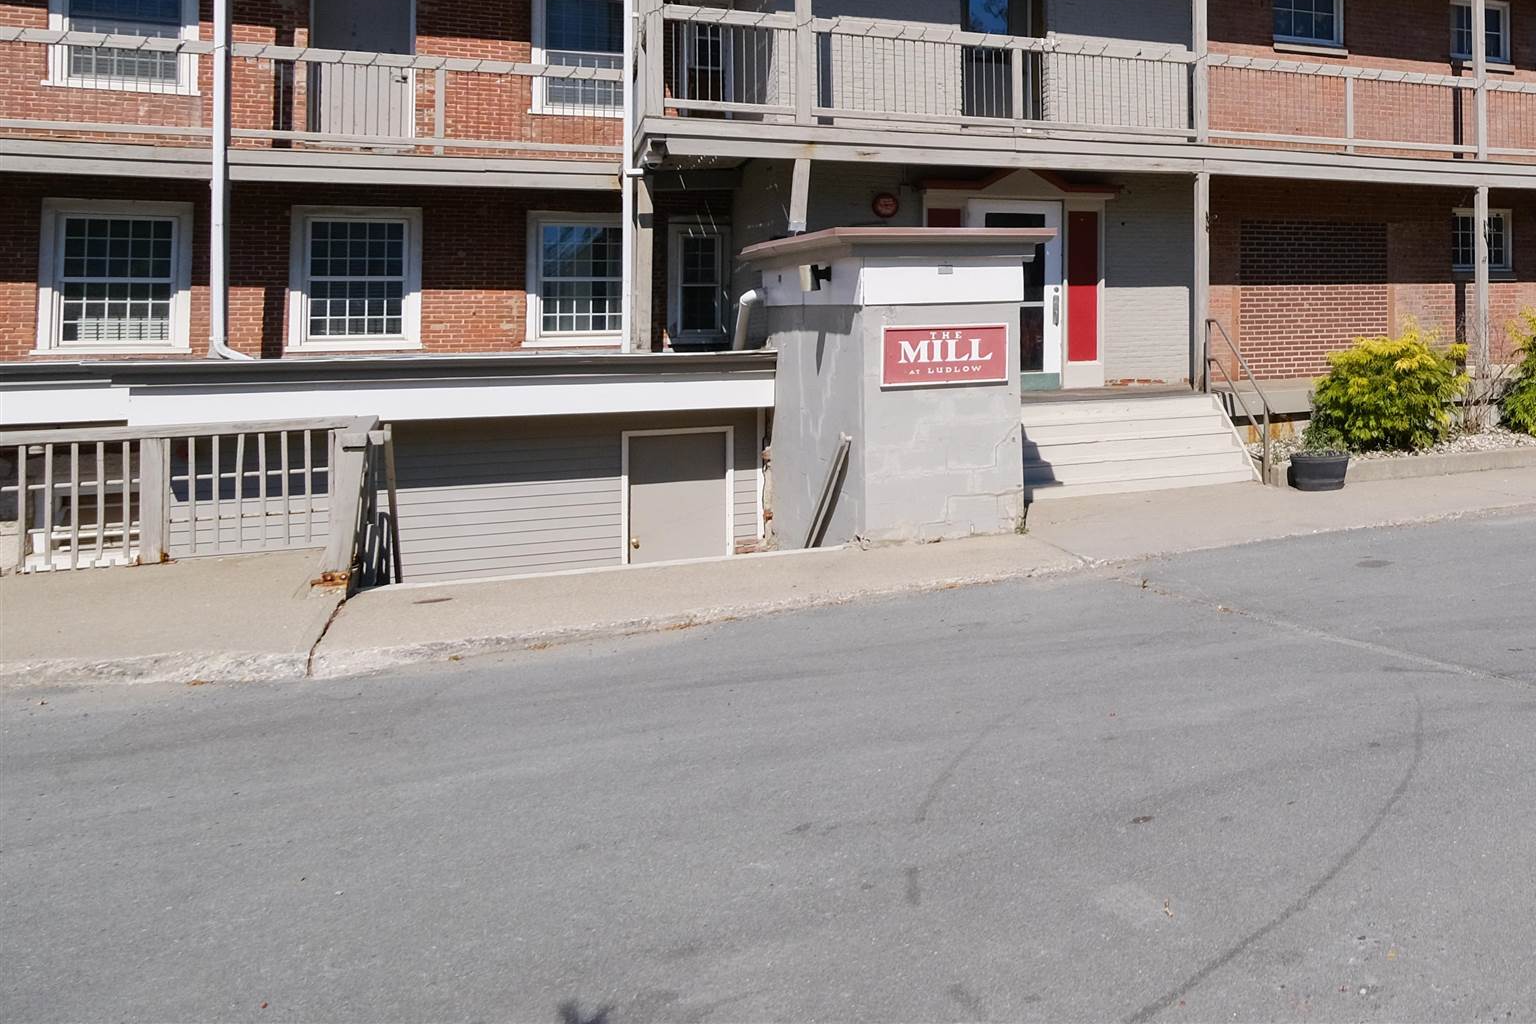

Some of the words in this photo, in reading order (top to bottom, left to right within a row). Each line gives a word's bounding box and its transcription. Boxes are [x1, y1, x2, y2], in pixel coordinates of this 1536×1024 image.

[930, 331, 962, 339] THE
[898, 338, 993, 364] MILL
[928, 365, 982, 374] LUDLOW
